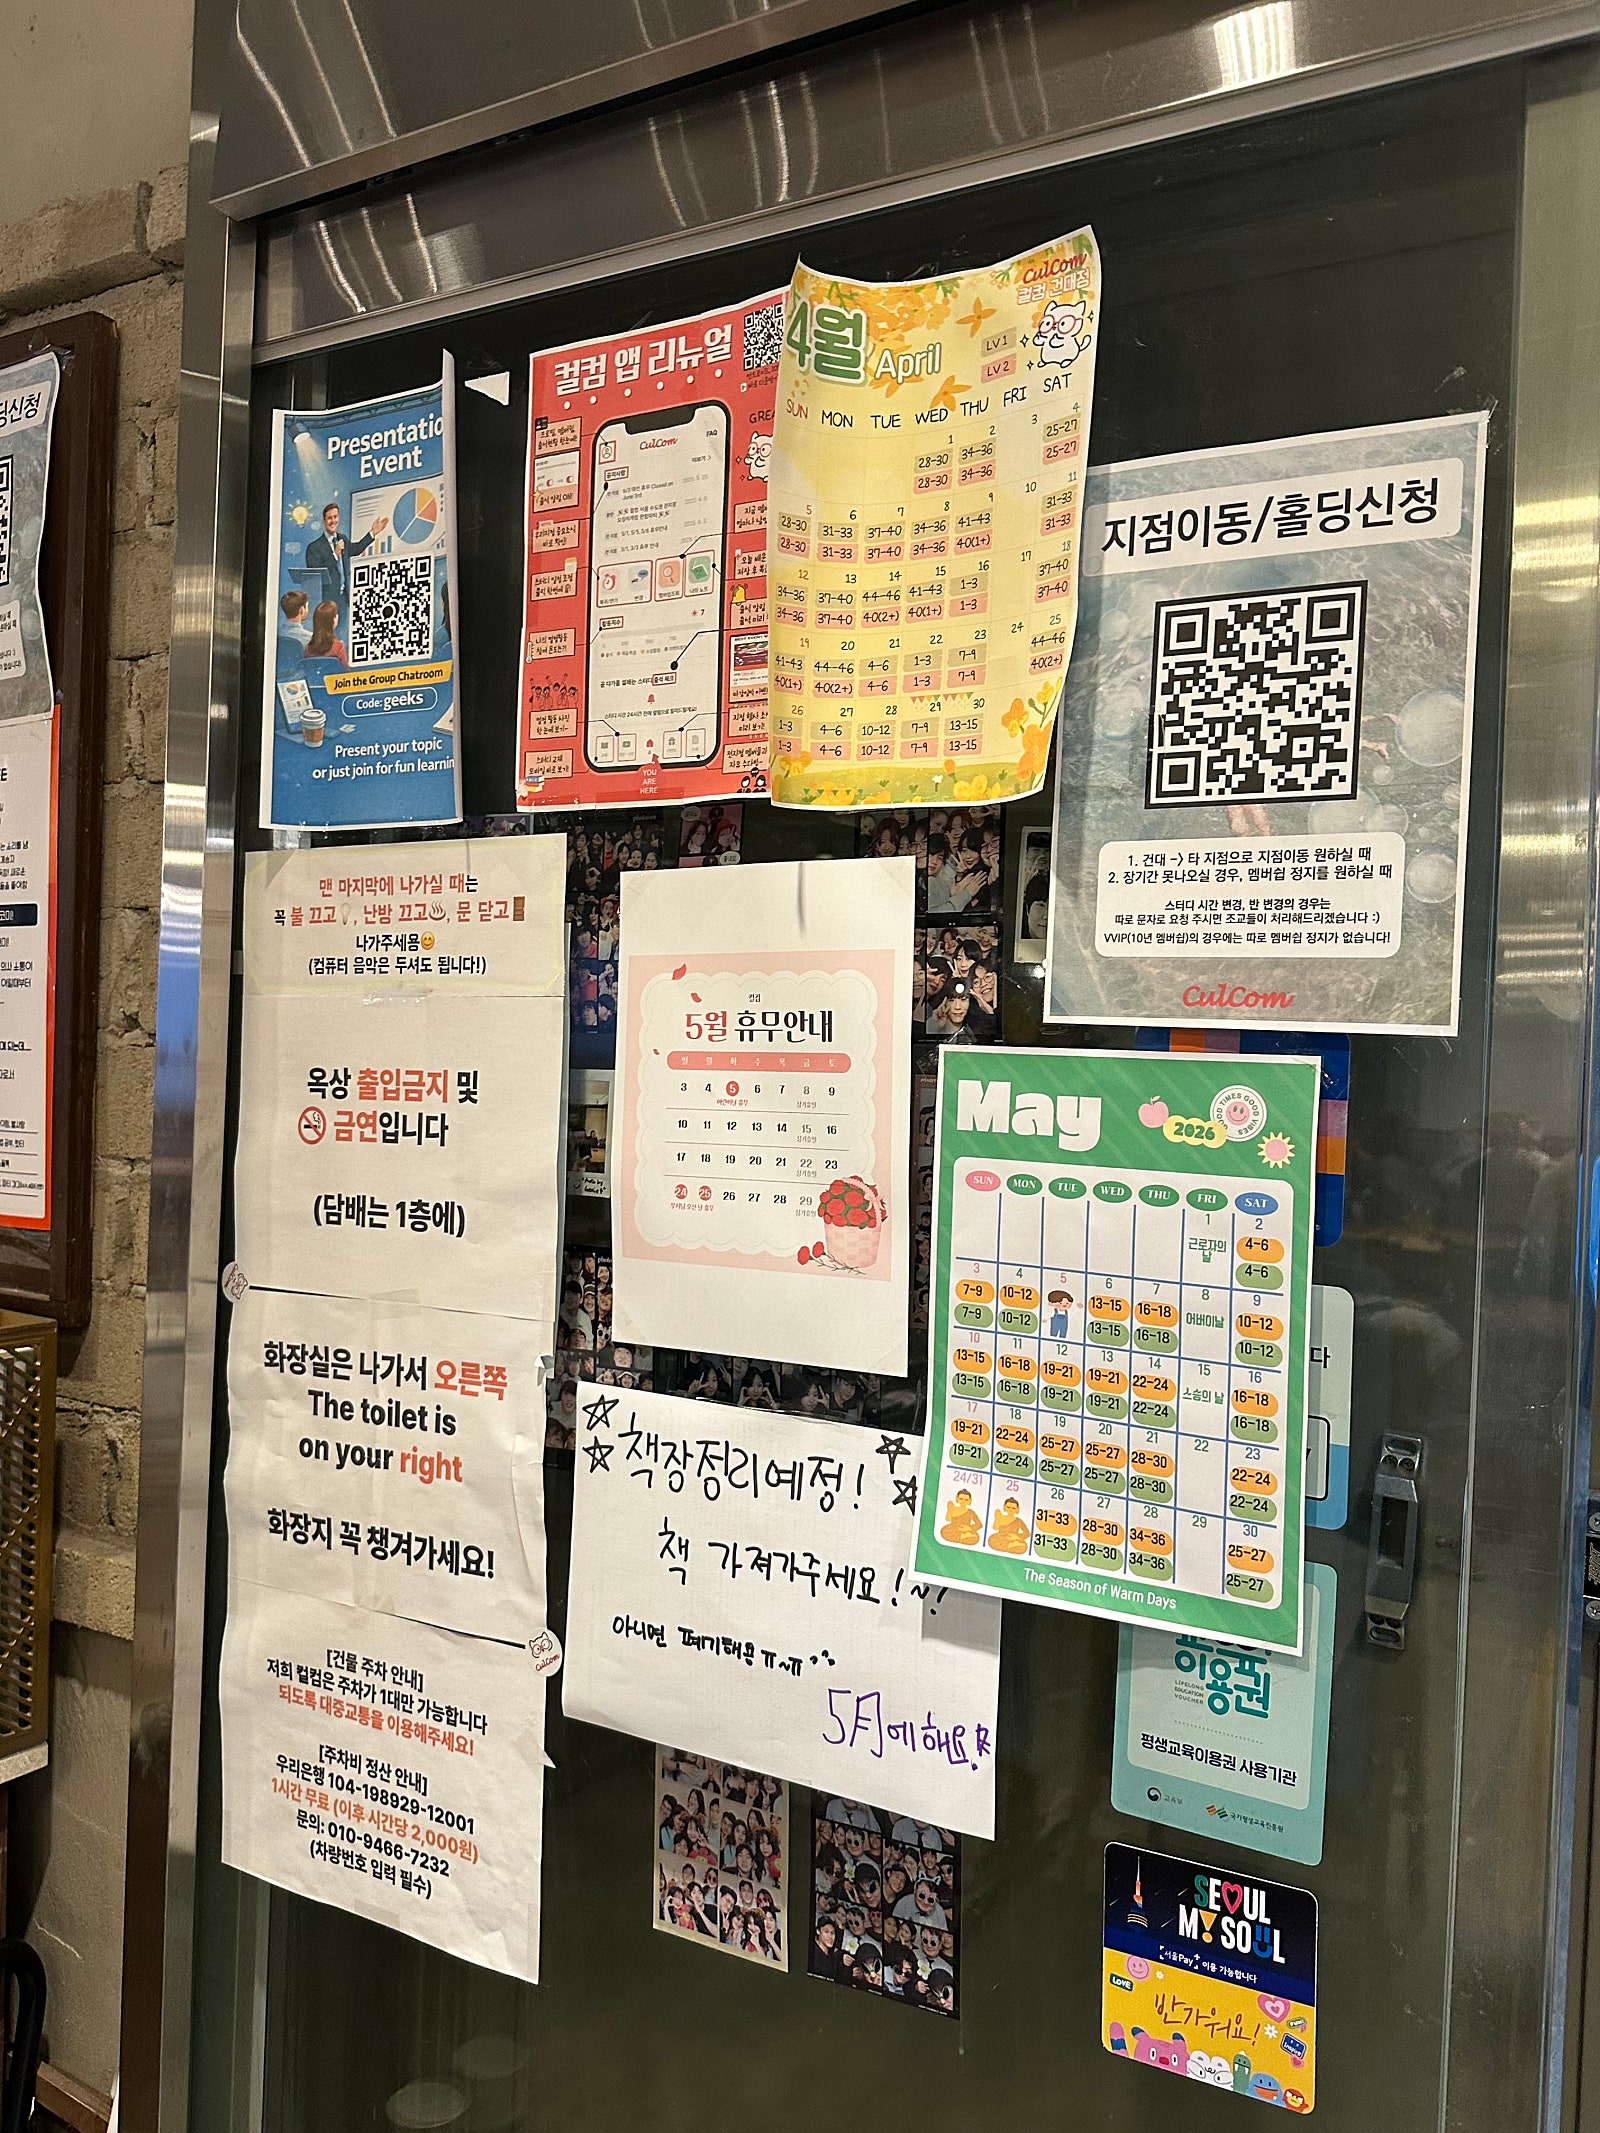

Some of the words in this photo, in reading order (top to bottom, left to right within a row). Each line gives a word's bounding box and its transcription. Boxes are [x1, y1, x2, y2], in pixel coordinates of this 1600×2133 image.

[1022, 252, 1088, 285] CulCom
[1018, 284, 1047, 305] 컬컴
[1048, 268, 1091, 297] 건대점
[786, 303, 866, 380] 4월
[986, 337, 1001, 351] LV
[554, 354, 607, 397] 컬컴
[614, 346, 642, 383] 앱
[649, 324, 733, 376] 리뉴얼
[874, 342, 942, 384] April
[986, 364, 1001, 378] LV
[1002, 361, 1010, 373] 2
[786, 398, 809, 420] SUN
[821, 411, 854, 428] MON
[870, 414, 902, 429] TUE
[915, 407, 949, 425] WED
[959, 397, 989, 416] THU
[1003, 386, 1027, 408] FRI
[1043, 373, 1072, 393] SAT
[327, 411, 444, 460] Presentatio
[639, 436, 678, 451] CulCom
[918, 454, 950, 469] 28-30
[961, 443, 993, 458] 34-36
[1046, 419, 1078, 437] 25-27
[360, 445, 423, 480] Event
[1101, 477, 1440, 557] 지점이동/홀딩신청
[334, 676, 351, 689] Join
[352, 675, 368, 687] the
[368, 673, 395, 688] Group
[397, 667, 443, 683] Chatroom
[356, 695, 383, 711] Code:
[382, 690, 424, 712] geeks
[861, 724, 891, 737] 10-12
[949, 718, 978, 732] 13-15
[335, 741, 380, 758] Present
[382, 742, 409, 758] your
[411, 737, 443, 756] topic
[312, 768, 327, 779] or
[327, 764, 350, 782] just
[350, 762, 374, 779] join
[375, 759, 393, 776] for
[394, 758, 415, 774] fun
[417, 756, 455, 772] learnin
[642, 768, 657, 777] YOU
[642, 777, 657, 786] ARE
[639, 786, 658, 795] HERE
[1128, 854, 1139, 867] 1.
[1142, 853, 1166, 867] 건대
[1188, 852, 1200, 866] 타
[1204, 850, 1253, 866] 지점으로
[1257, 848, 1309, 864] 지점이동
[1313, 847, 1353, 863] 원하실
[1358, 846, 1372, 862] 때
[319, 877, 333, 898] 맨
[338, 876, 394, 898] 마지막에
[400, 874, 443, 896] 나가실
[449, 874, 479, 894] 때는
[1108, 871, 1119, 885] 2.
[1123, 868, 1159, 885] 장기간
[1162, 868, 1210, 884] 못나오실
[1215, 866, 1243, 883] 경우,
[1247, 865, 1286, 882] 멤버쉽
[1291, 865, 1329, 881] 정지를
[1333, 864, 1374, 880] 원하실
[1379, 864, 1392, 880] 때
[274, 909, 286, 927] 꼭
[290, 905, 303, 927] 불
[309, 905, 337, 926] 끄고
[363, 904, 393, 926] 난방
[399, 902, 428, 926] 끄고
[456, 901, 473, 923] 문
[478, 900, 510, 922] 닫고
[355, 932, 420, 952] 나가주세용
[308, 956, 349, 976] (컴퓨터
[352, 956, 391, 976] 음악은
[395, 955, 434, 975] 두셔도
[437, 955, 487, 976] 됩니다!)
[1182, 982, 1296, 1010] CulCom
[685, 1010, 728, 1043] 5월
[734, 1009, 834, 1043] 휴무안내
[306, 1066, 352, 1101] 옥상
[356, 1068, 449, 1104] 출입금지
[456, 1070, 479, 1105] 및
[333, 1109, 449, 1147] 금연입니다
[956, 1079, 1102, 1152] May
[1173, 1121, 1216, 1140] 2026
[973, 1174, 994, 1186] SUN
[1012, 1178, 1037, 1189] MON
[1058, 1182, 1078, 1193] TUE
[1100, 1185, 1125, 1198] WED
[1147, 1189, 1171, 1201] THU
[1196, 1193, 1217, 1206] FRI
[1244, 1197, 1268, 1209] SAT
[313, 1193, 389, 1230] (담배는
[394, 1199, 466, 1239] 1층에)
[1188, 1237, 1227, 1254] 근로자의
[1202, 1250, 1212, 1264] 날
[963, 1284, 983, 1298] 7-9
[1002, 1285, 1033, 1301] 10-12
[1137, 1302, 1172, 1318] 16-18
[1186, 1311, 1225, 1330] 어버이날
[263, 1340, 353, 1382] 화장실은
[359, 1350, 428, 1391] 나가서
[433, 1360, 508, 1401] 오른쪽
[308, 1388, 354, 1422] The
[361, 1397, 428, 1432] toilet
[435, 1404, 457, 1436] is
[1183, 1388, 1212, 1404] 스승의
[1214, 1390, 1225, 1405] 날
[299, 1436, 329, 1461] on
[335, 1441, 394, 1470] your
[400, 1445, 463, 1485] right
[953, 1470, 984, 1487] 24/31
[267, 1507, 333, 1551] 화장지
[339, 1519, 362, 1556] 꼭
[366, 1525, 496, 1579] 챙겨가세요!
[657, 1516, 690, 1586] 책
[1023, 1568, 1046, 1584] The
[1047, 1573, 1092, 1594] Season
[1093, 1579, 1109, 1597] of
[1110, 1584, 1145, 1604] Warm
[1146, 1591, 1177, 1611] Days
[612, 1614, 668, 1649] 아니면
[677, 1625, 757, 1667] 폐기해용
[1174, 1693, 1204, 1705] VOUCHER
[1141, 1732, 1237, 1772] 평생교육이용권
[1239, 1758, 1298, 1787] 사용기관
[275, 1754, 326, 1787] 우리은행
[328, 1772, 476, 1835] 104-198929-12001
[296, 1808, 325, 1837] 문의:
[327, 1822, 450, 1878] 010-9466-7232
[1112, 1976, 1132, 1990] LOVE
[1219, 1965, 1257, 1984] 가능합니다
[1155, 1993, 1261, 2047] 반가워요!
